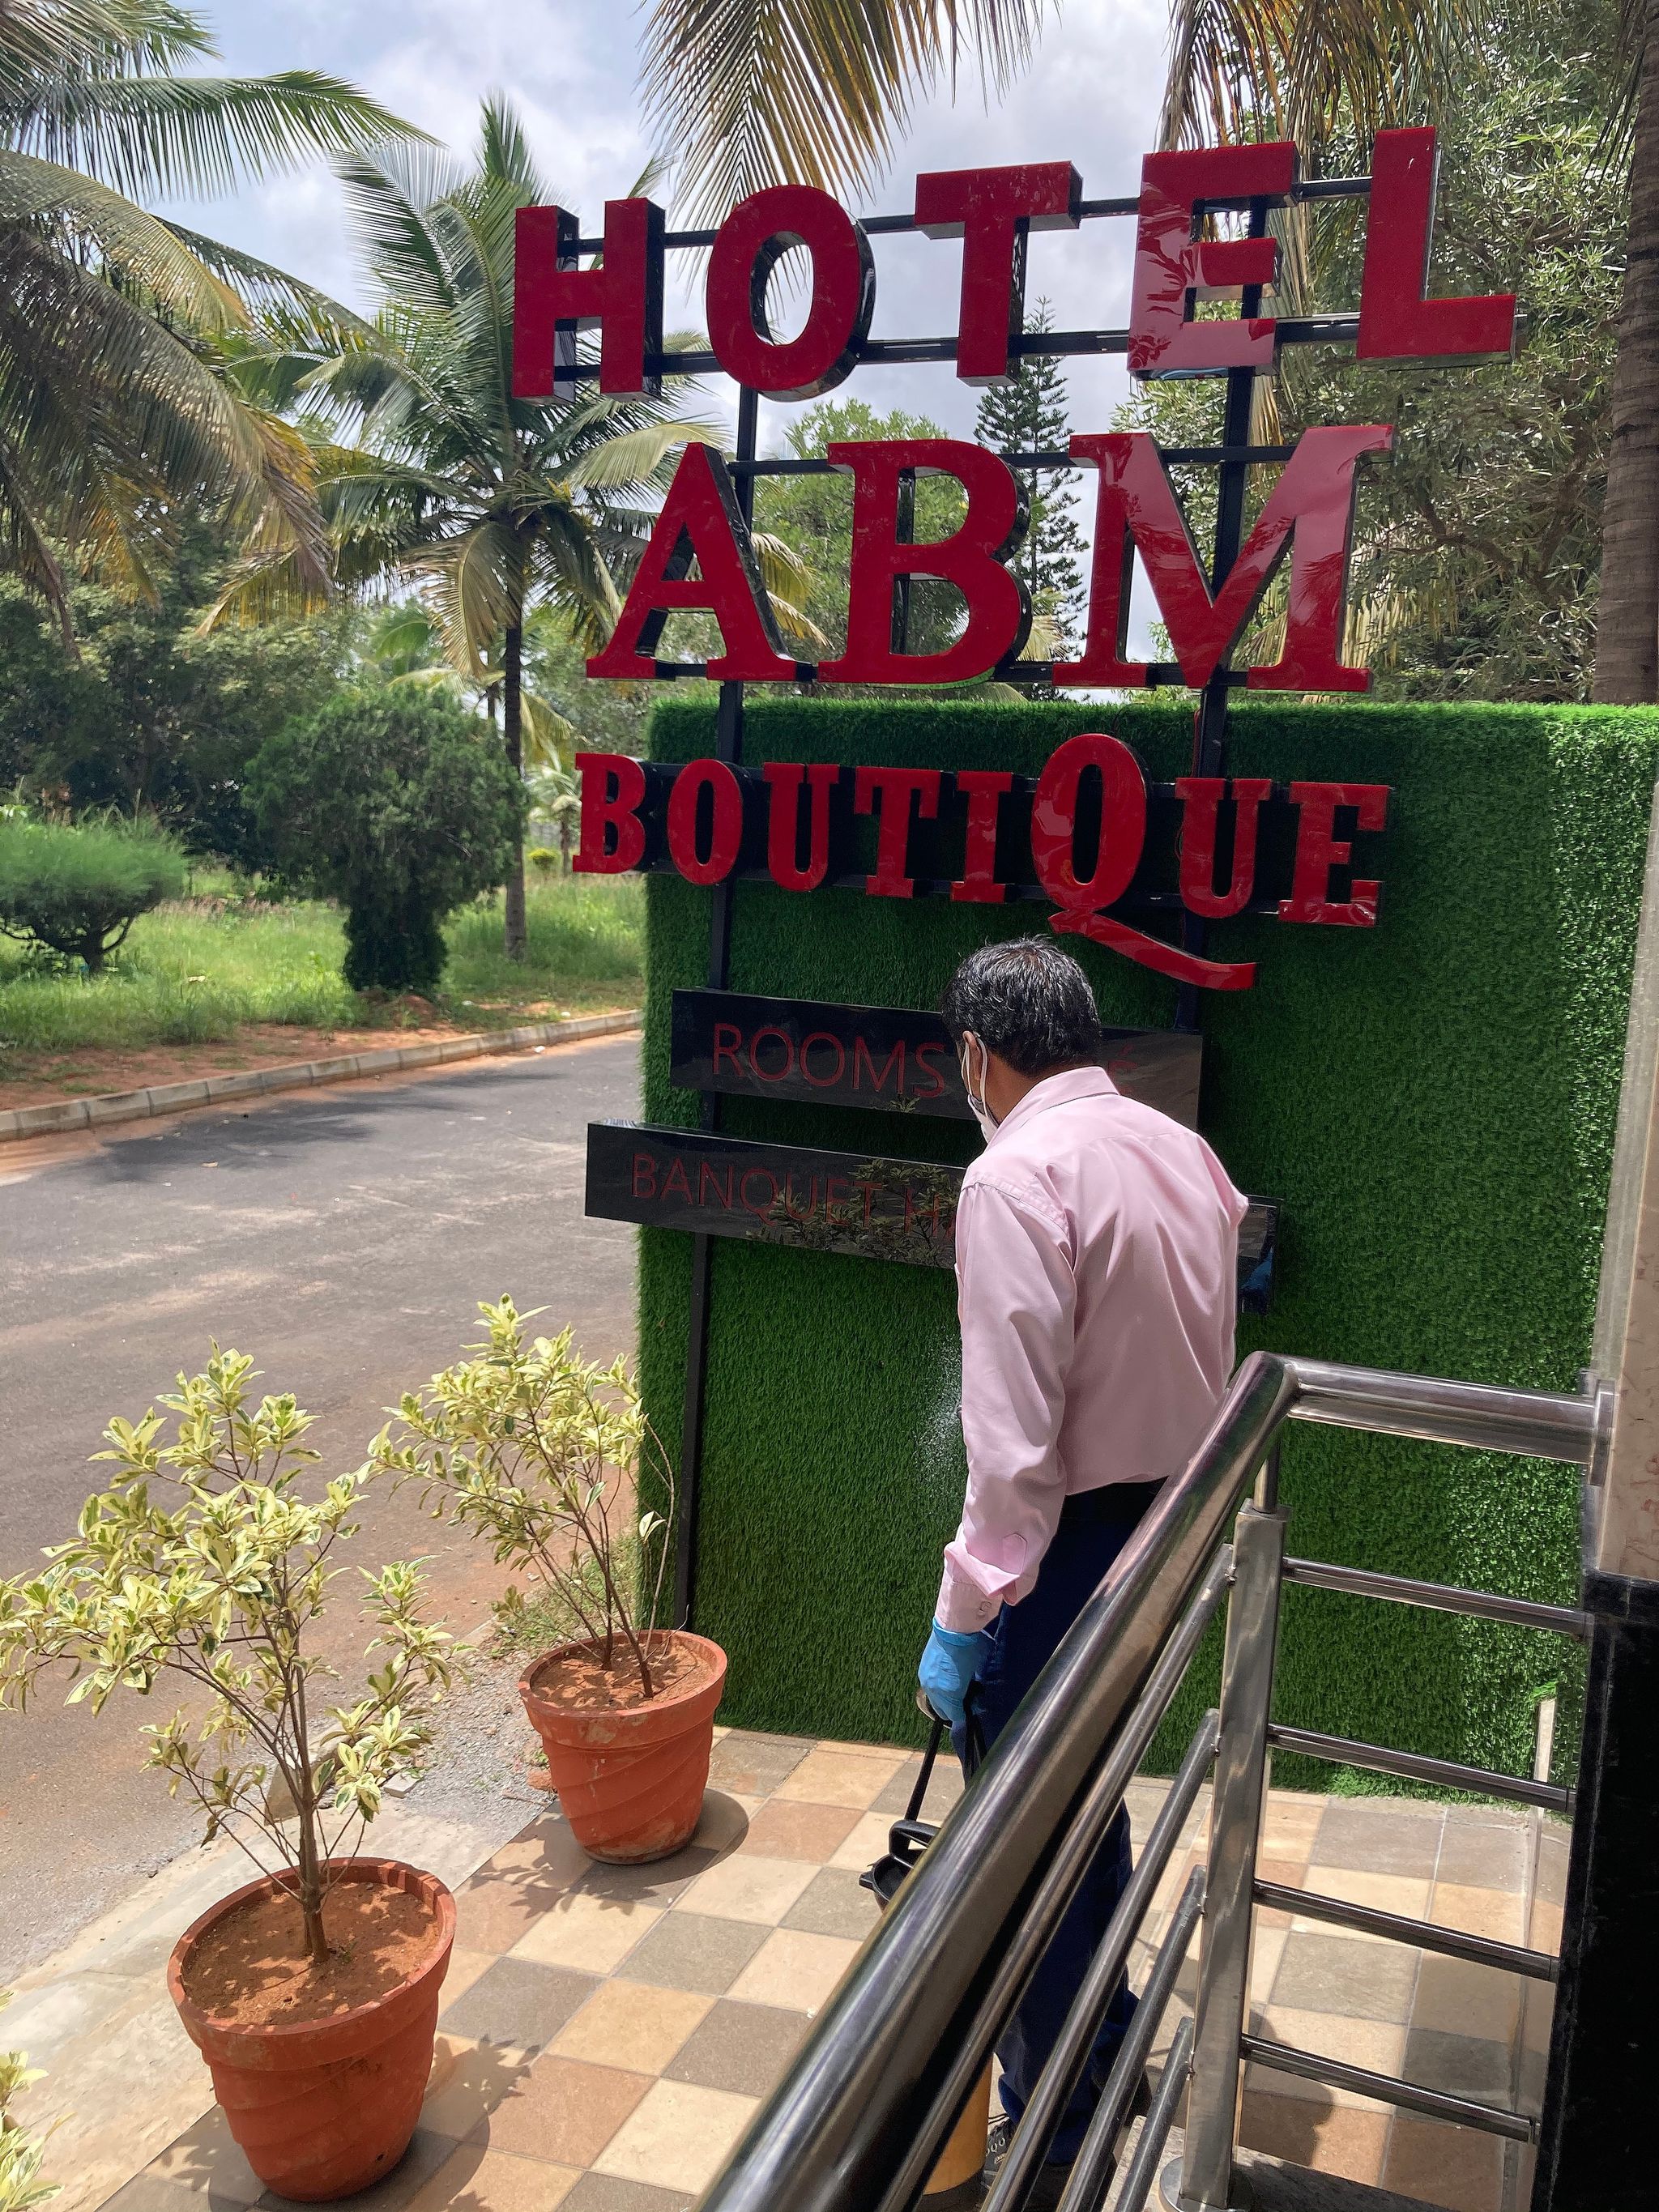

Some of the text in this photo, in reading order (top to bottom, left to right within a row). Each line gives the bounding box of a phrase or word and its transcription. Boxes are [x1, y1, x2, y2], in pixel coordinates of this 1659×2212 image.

[512, 126, 1517, 399] HOTEL
[586, 424, 1394, 692] ABM
[572, 733, 1390, 990] BOUTIQUE
[713, 1022, 945, 1098] ROOMS
[632, 1153, 883, 1229] BANQUET
